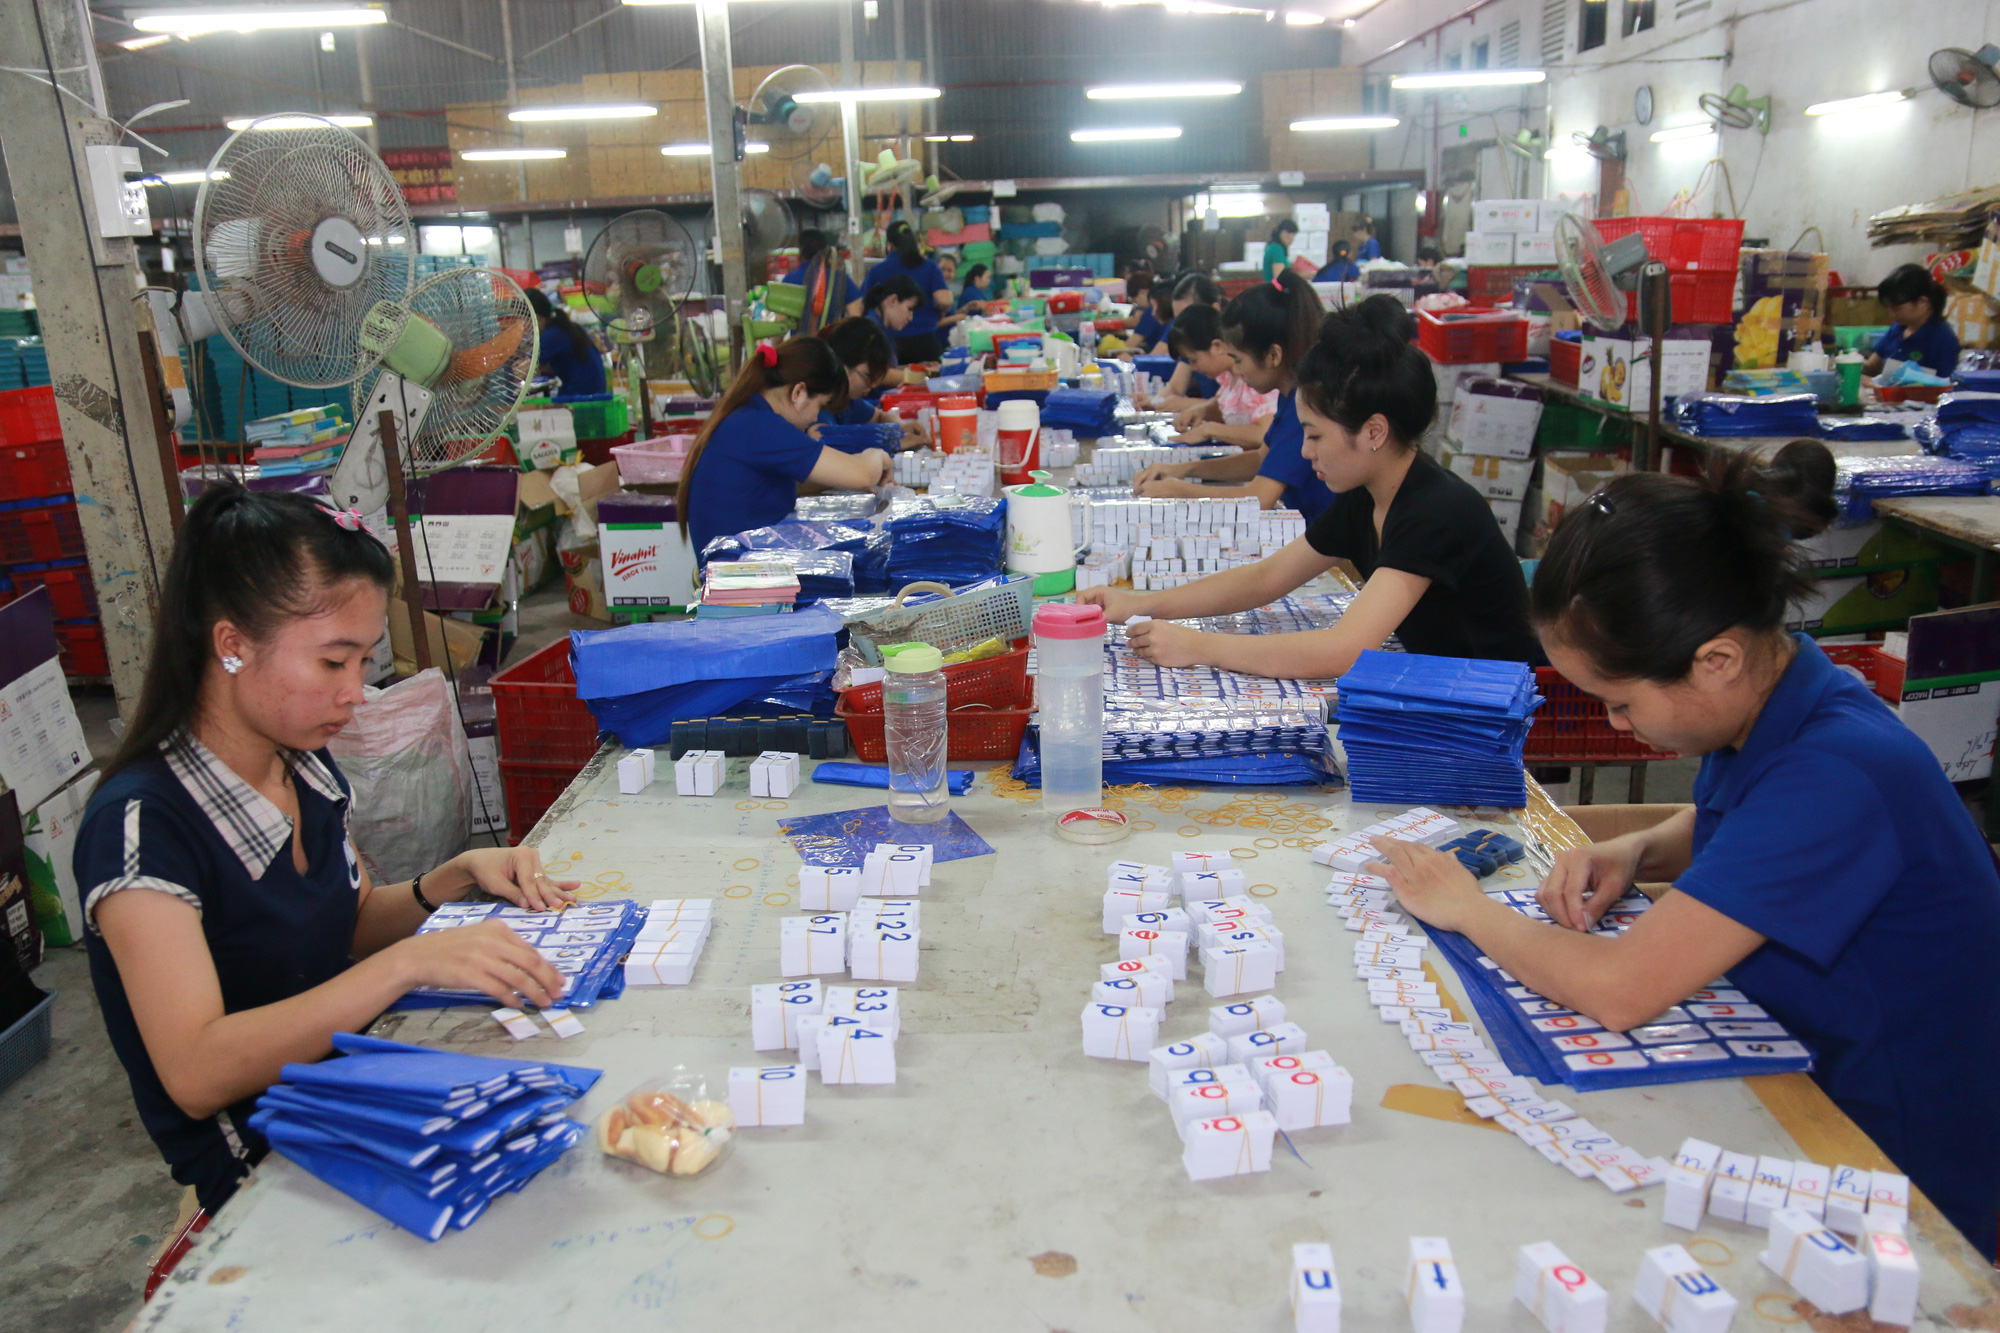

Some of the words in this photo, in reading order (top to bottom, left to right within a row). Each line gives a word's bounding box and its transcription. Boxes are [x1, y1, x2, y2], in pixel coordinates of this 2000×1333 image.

[889, 854, 916, 862] 0
[1117, 873, 1147, 882] k
[810, 915, 840, 924] 6
[1136, 912, 1168, 924] g
[876, 921, 907, 930] 2
[881, 933, 911, 941] 2
[779, 982, 812, 992] 8
[780, 994, 813, 1004] 9
[856, 989, 888, 999] 3
[855, 1002, 888, 1012] 3
[828, 1016, 861, 1026] 4
[849, 1029, 883, 1040] 4
[760, 1065, 796, 1080] 10
